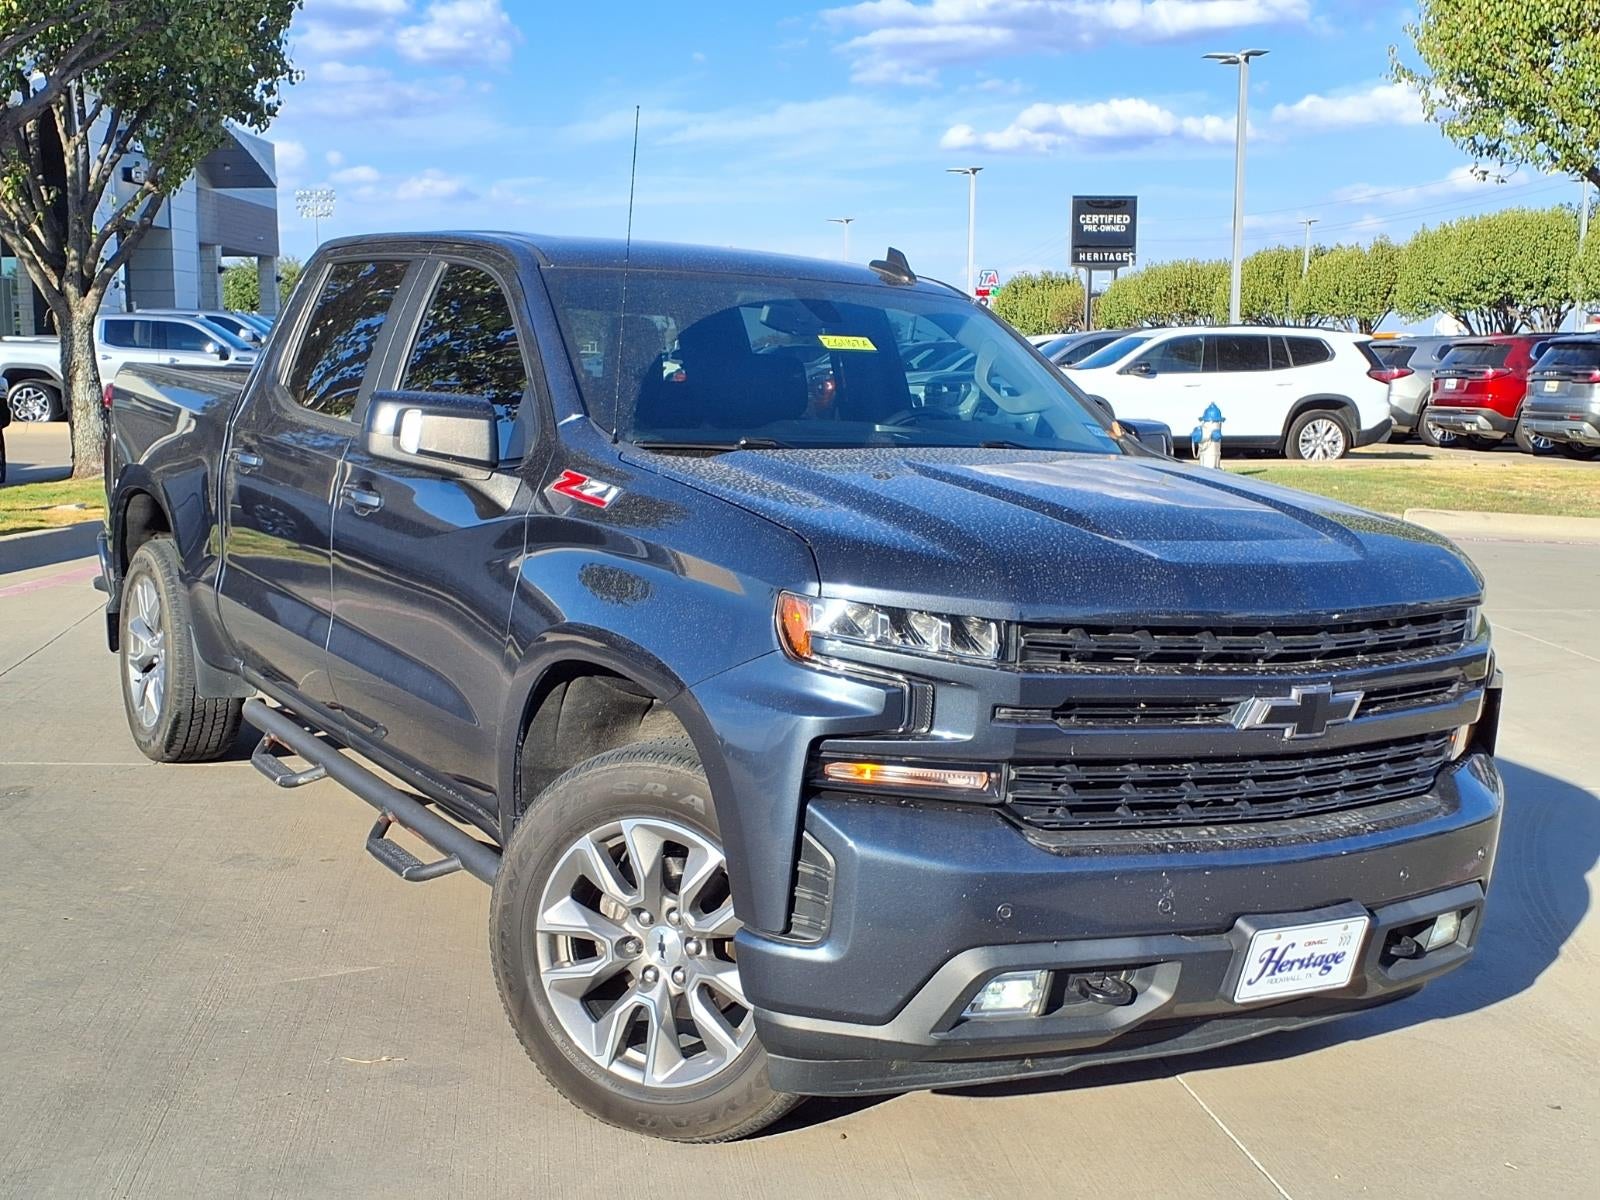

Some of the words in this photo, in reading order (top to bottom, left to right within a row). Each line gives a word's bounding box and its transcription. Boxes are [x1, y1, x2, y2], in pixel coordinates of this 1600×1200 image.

[1079, 214, 1131, 224] CERTIFIED
[1083, 224, 1126, 232] PRE-OWNED
[1079, 252, 1129, 261] HERITAGE
[551, 469, 622, 509] Z71
[1304, 938, 1328, 948] GMC
[1246, 942, 1347, 986] Heritage
